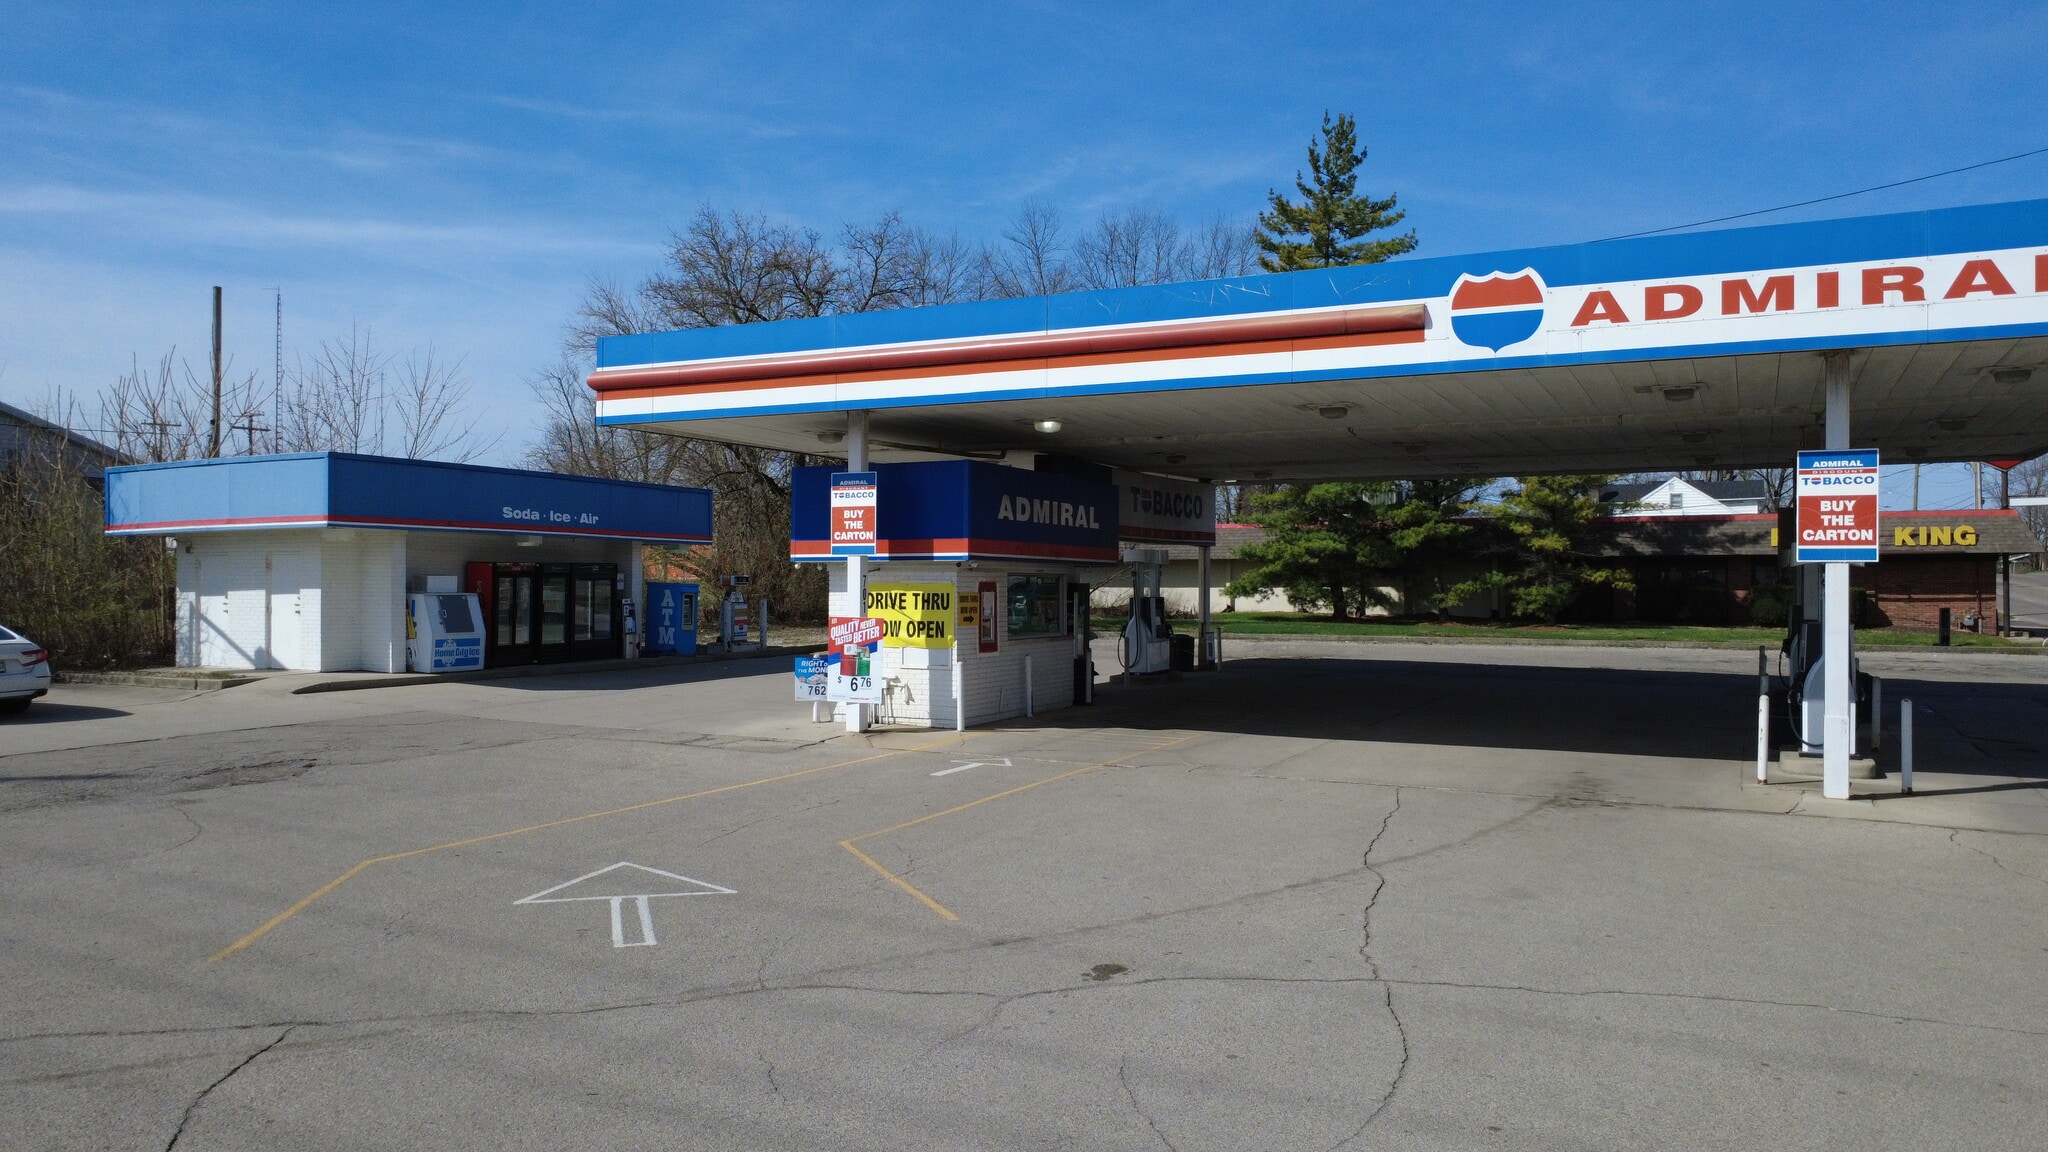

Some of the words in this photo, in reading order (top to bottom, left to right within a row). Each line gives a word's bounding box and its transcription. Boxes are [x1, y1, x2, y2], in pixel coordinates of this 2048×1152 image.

[1570, 254, 2048, 327] ADMIRA
[502, 506, 540, 521] Soda
[549, 510, 571, 523] Ice
[579, 512, 599, 524] Air
[843, 509, 864, 519] BUY
[997, 494, 1100, 530] ADMIRAL
[1820, 500, 1857, 512] BUY
[844, 521, 864, 529] THE
[1820, 514, 1855, 526] THE
[834, 531, 873, 540] CARTON
[1802, 529, 1873, 541] CARTON
[1894, 525, 1977, 547] KING
[868, 592, 907, 610] DRIVE
[912, 593, 950, 611] THRU
[657, 589, 675, 645] ATM
[830, 618, 860, 640] QUALITY
[859, 618, 876, 630] NEVER
[835, 633, 853, 646] TASTED
[853, 626, 880, 644] BETTER
[883, 620, 901, 637] OW
[906, 620, 945, 638] OPEN
[434, 649, 455, 657] Home
[455, 648, 469, 657] City
[469, 648, 480, 656] Ice
[808, 686, 826, 696] 762
